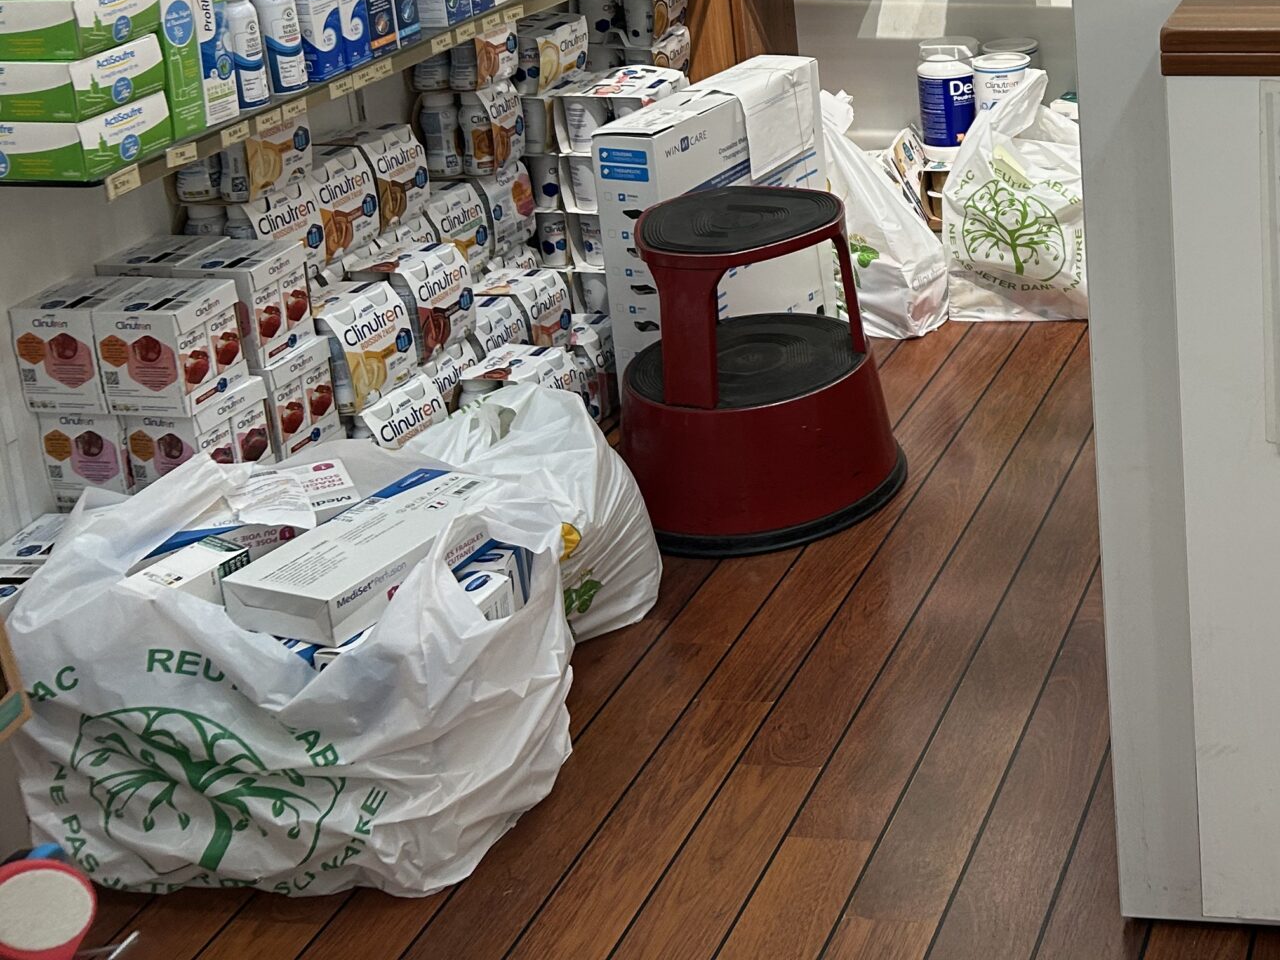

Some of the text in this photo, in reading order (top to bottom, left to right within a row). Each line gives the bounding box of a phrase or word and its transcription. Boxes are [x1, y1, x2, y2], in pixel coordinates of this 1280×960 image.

[96, 49, 135, 69] ActiSoufre
[104, 106, 143, 127] ActiSoufre
[377, 142, 423, 174] Clinutren
[319, 168, 371, 204] Clinutren
[258, 198, 316, 236] Clinutren
[441, 202, 483, 233] Clinutren
[418, 263, 467, 301] Clinutren
[976, 269, 1016, 291] JETER
[531, 287, 567, 320] Clinutren
[374, 561, 407, 587] Perfusion
[27, 664, 79, 702] AC
